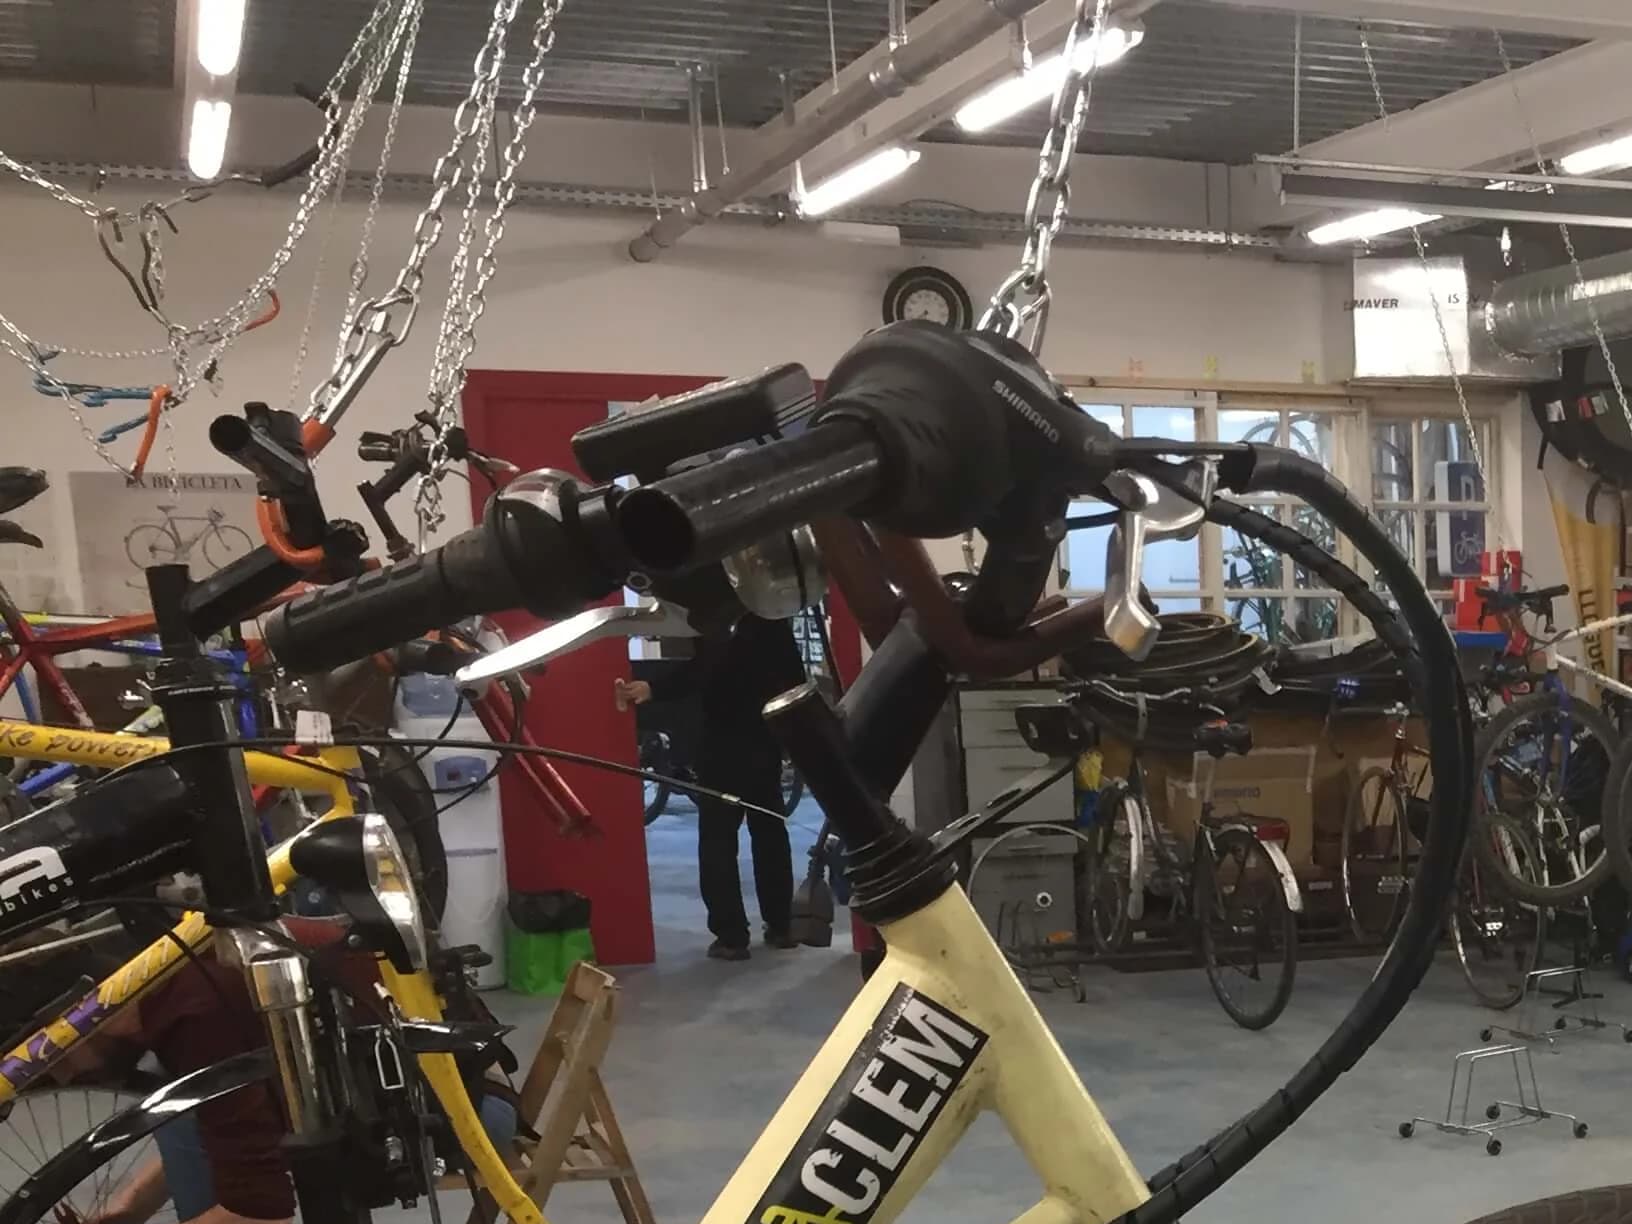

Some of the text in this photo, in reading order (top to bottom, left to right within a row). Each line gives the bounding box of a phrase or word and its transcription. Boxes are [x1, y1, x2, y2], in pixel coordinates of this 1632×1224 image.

[992, 380, 1059, 441] SHIMANO
[152, 475, 243, 489] BIICLETA
[0, 876, 74, 916] bikes
